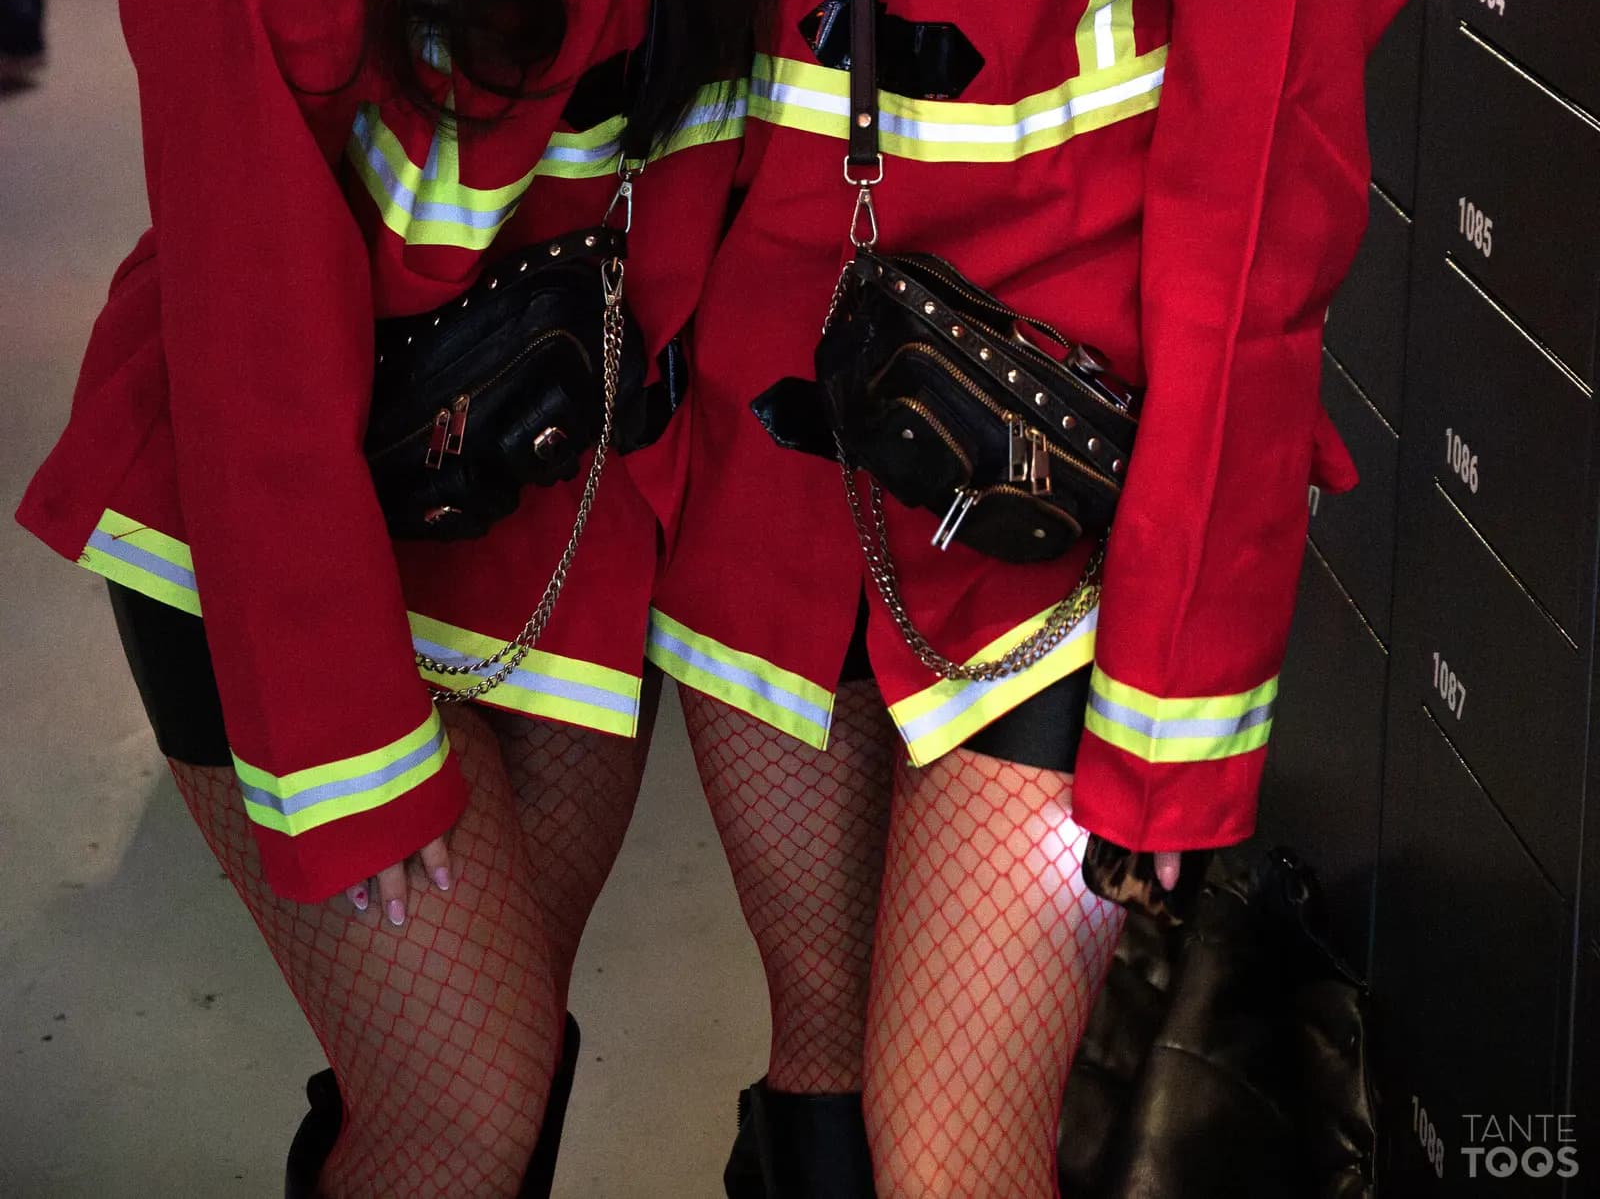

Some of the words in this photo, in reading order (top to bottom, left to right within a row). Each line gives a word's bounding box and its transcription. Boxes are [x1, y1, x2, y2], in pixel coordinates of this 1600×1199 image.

[1457, 196, 1493, 258] 1085
[1445, 427, 1479, 494] 1086
[1433, 651, 1466, 721] 1087
[1411, 1094, 1445, 1179] 1088
